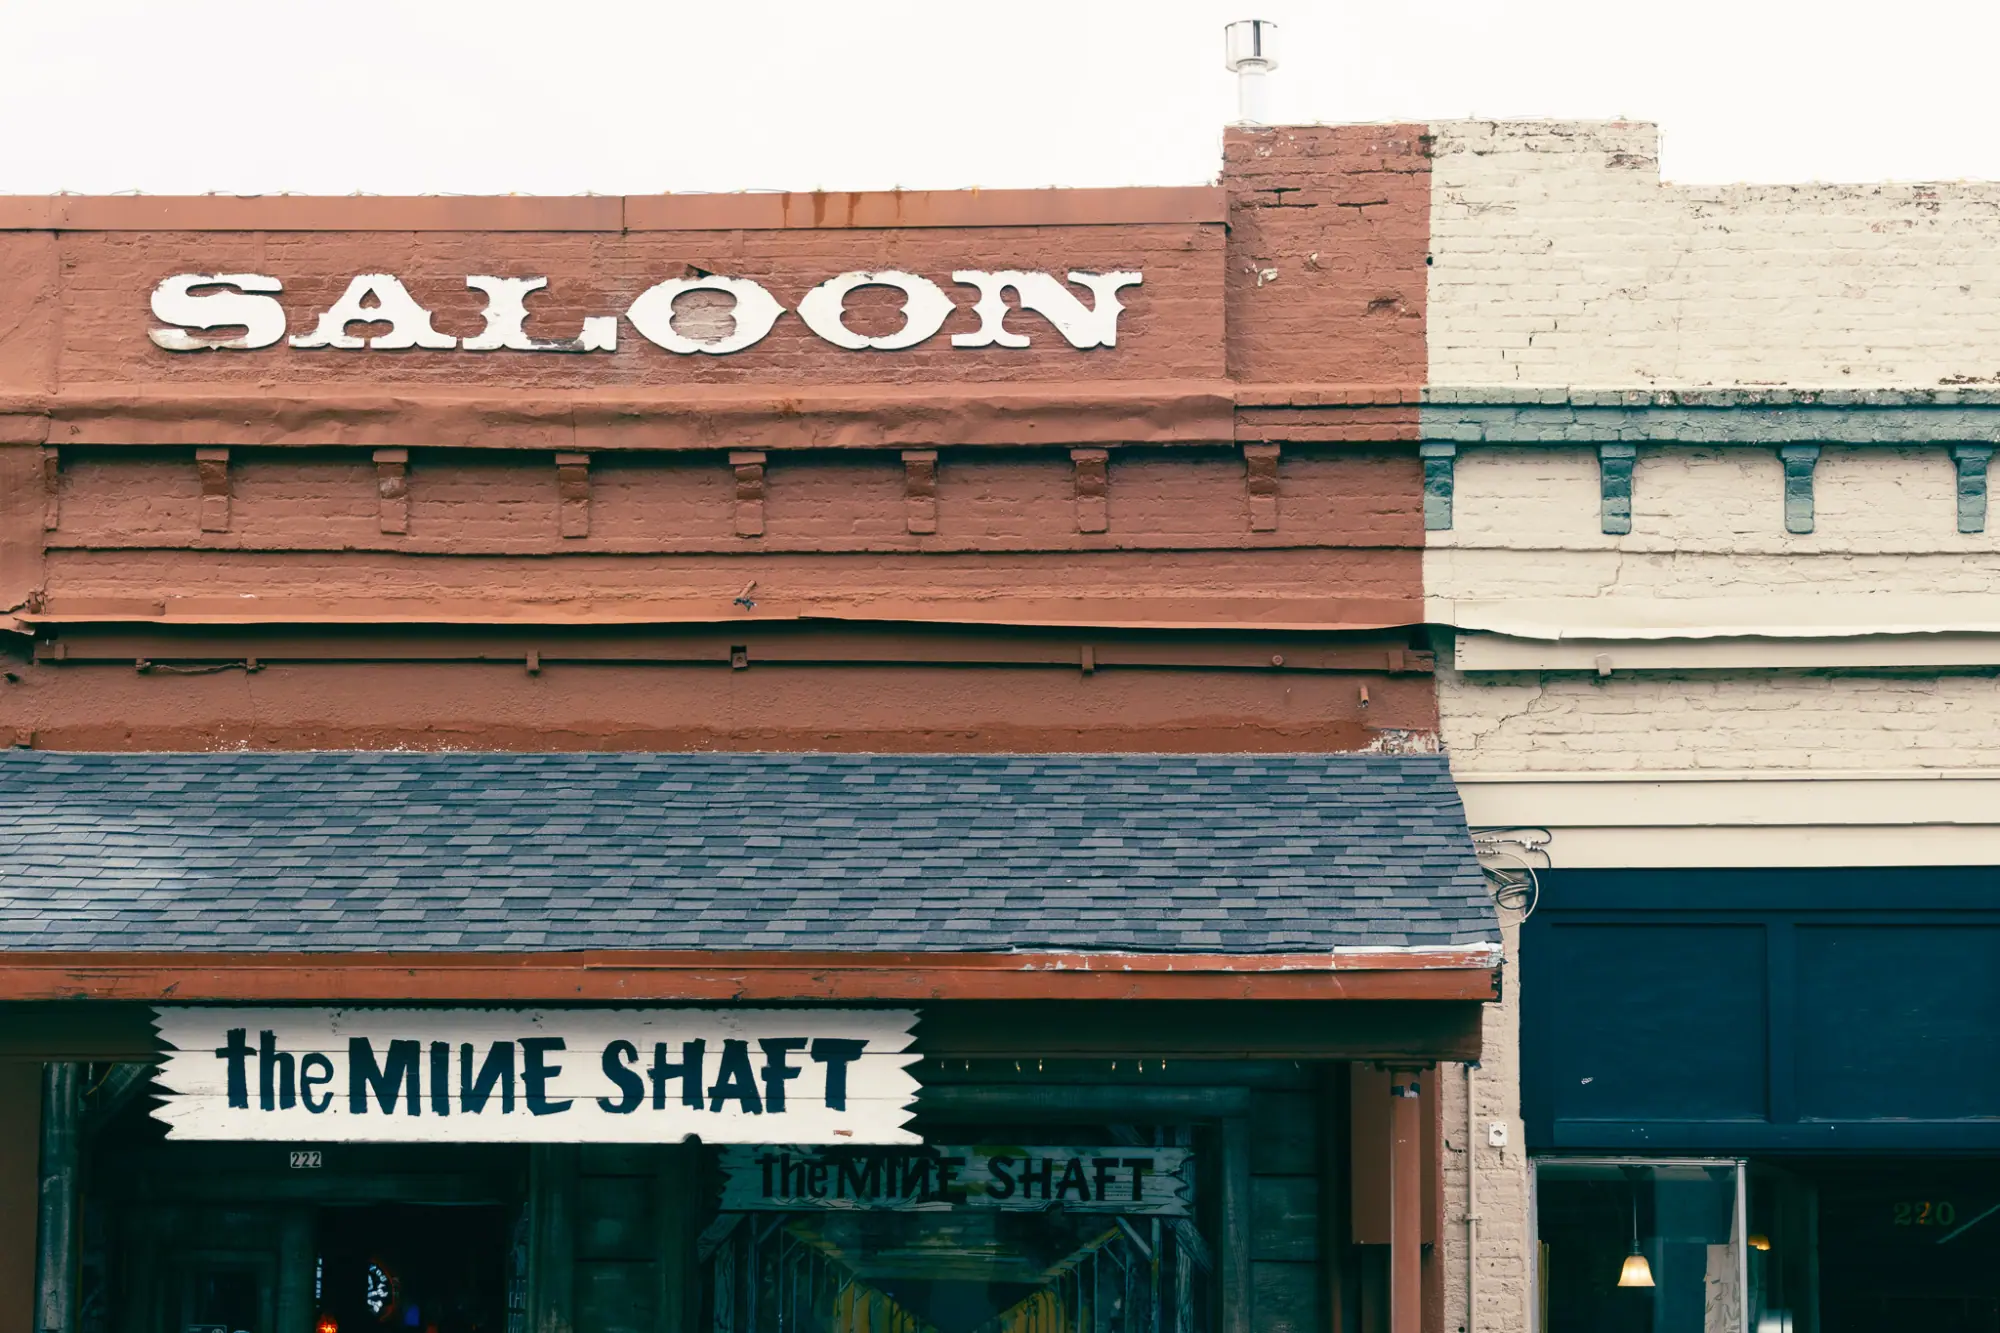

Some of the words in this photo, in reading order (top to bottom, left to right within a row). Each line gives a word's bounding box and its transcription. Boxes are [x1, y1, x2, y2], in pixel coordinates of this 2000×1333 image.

[149, 270, 1142, 353] SALOON
[215, 1028, 334, 1114] the
[596, 1037, 869, 1114] SHAFT
[291, 1151, 321, 1168] 222
[755, 1153, 828, 1198] the
[985, 1155, 1153, 1201] SHAFT
[1892, 1200, 1956, 1226] 220
